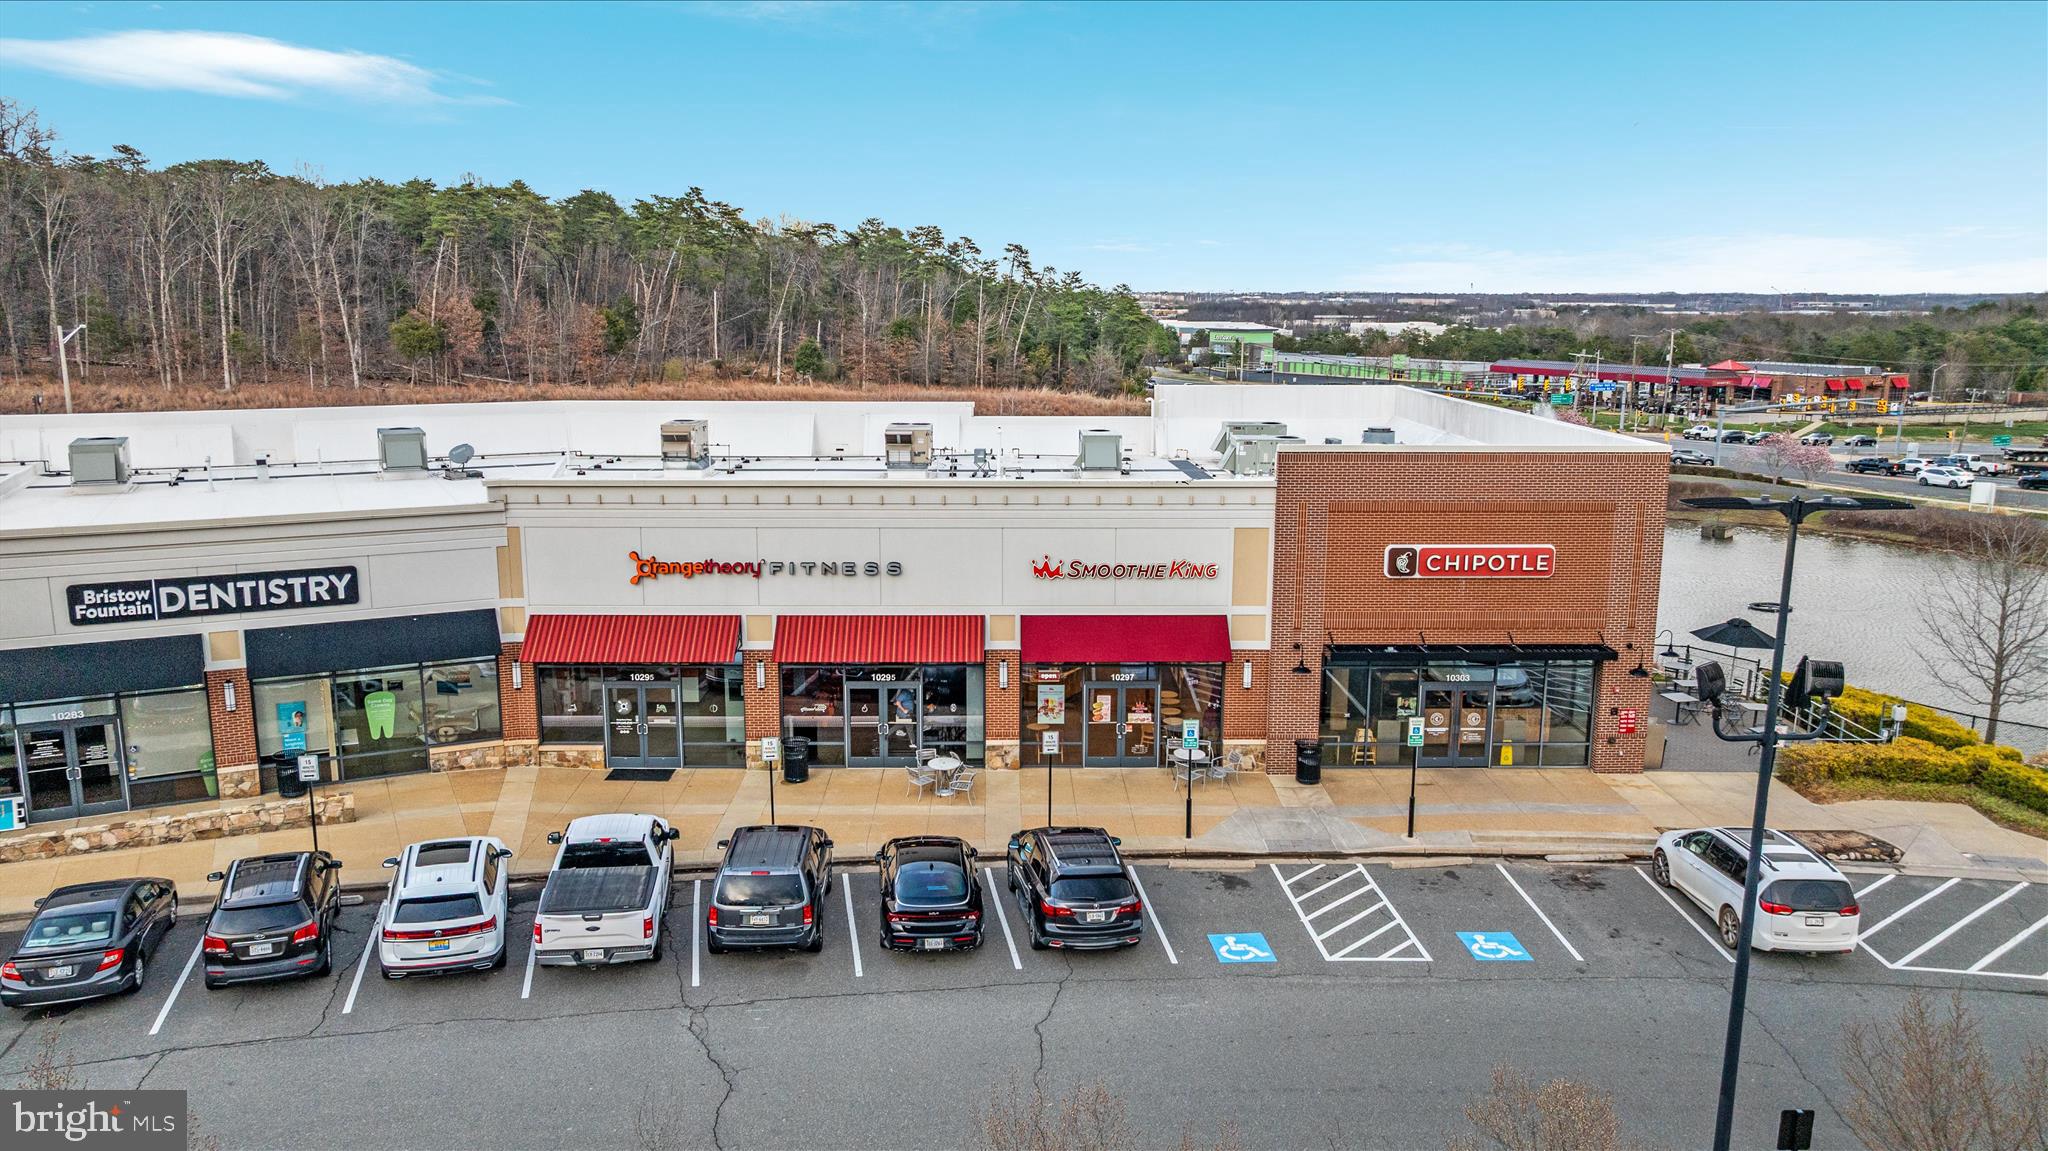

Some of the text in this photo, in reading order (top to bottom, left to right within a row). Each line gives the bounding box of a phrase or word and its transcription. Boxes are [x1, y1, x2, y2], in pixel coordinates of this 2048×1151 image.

[769, 561, 903, 577] FITNESS
[1067, 559, 1167, 579] SMOOTHIE
[1426, 554, 1550, 572] CHIPOTLE
[83, 588, 151, 605] Bristow
[159, 573, 351, 613] DENTISTRY
[75, 601, 153, 620] Fountain
[630, 673, 655, 681] 10295
[871, 673, 896, 681] 10295
[1110, 673, 1135, 681] 10297
[1446, 674, 1470, 682] 10303
[51, 710, 85, 720] 10283
